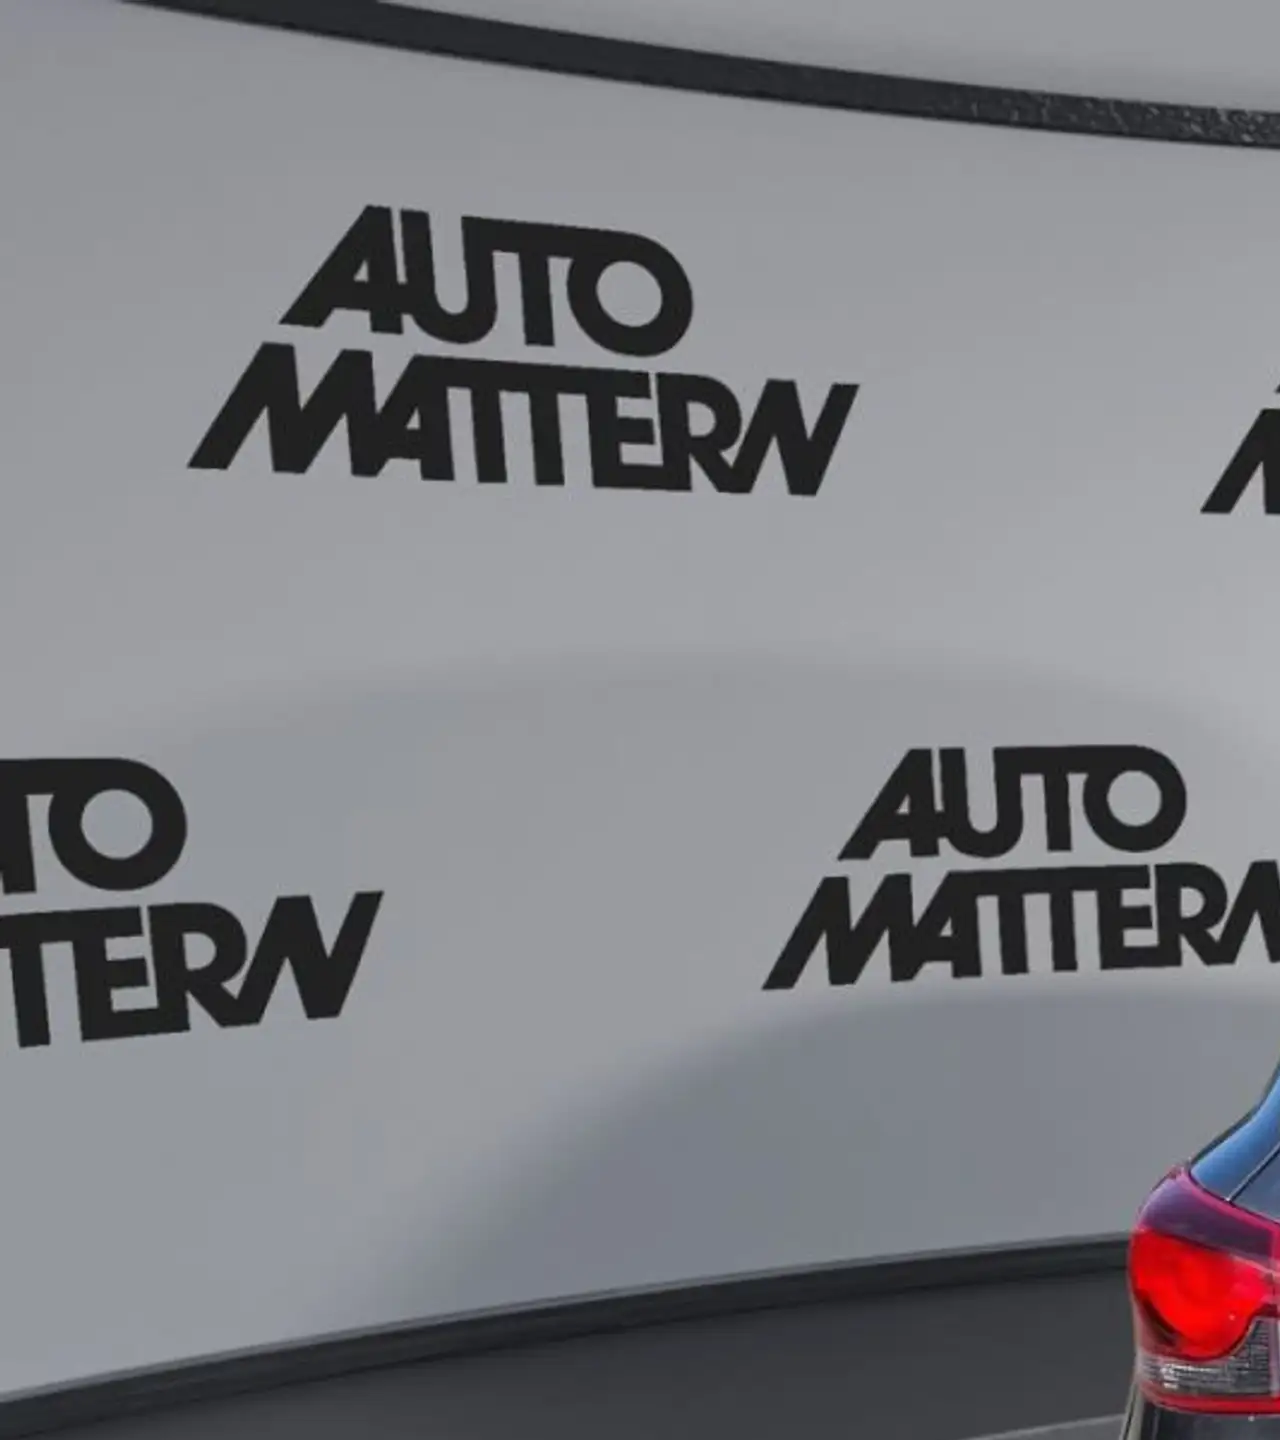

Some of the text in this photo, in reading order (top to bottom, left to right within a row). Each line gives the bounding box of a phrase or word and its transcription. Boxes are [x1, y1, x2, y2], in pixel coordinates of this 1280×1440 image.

[280, 205, 693, 357] AUTO
[188, 342, 859, 496] MATTERN
[0, 758, 187, 894] TO
[838, 745, 1186, 861] AUTO
[0, 891, 383, 1048] TERN
